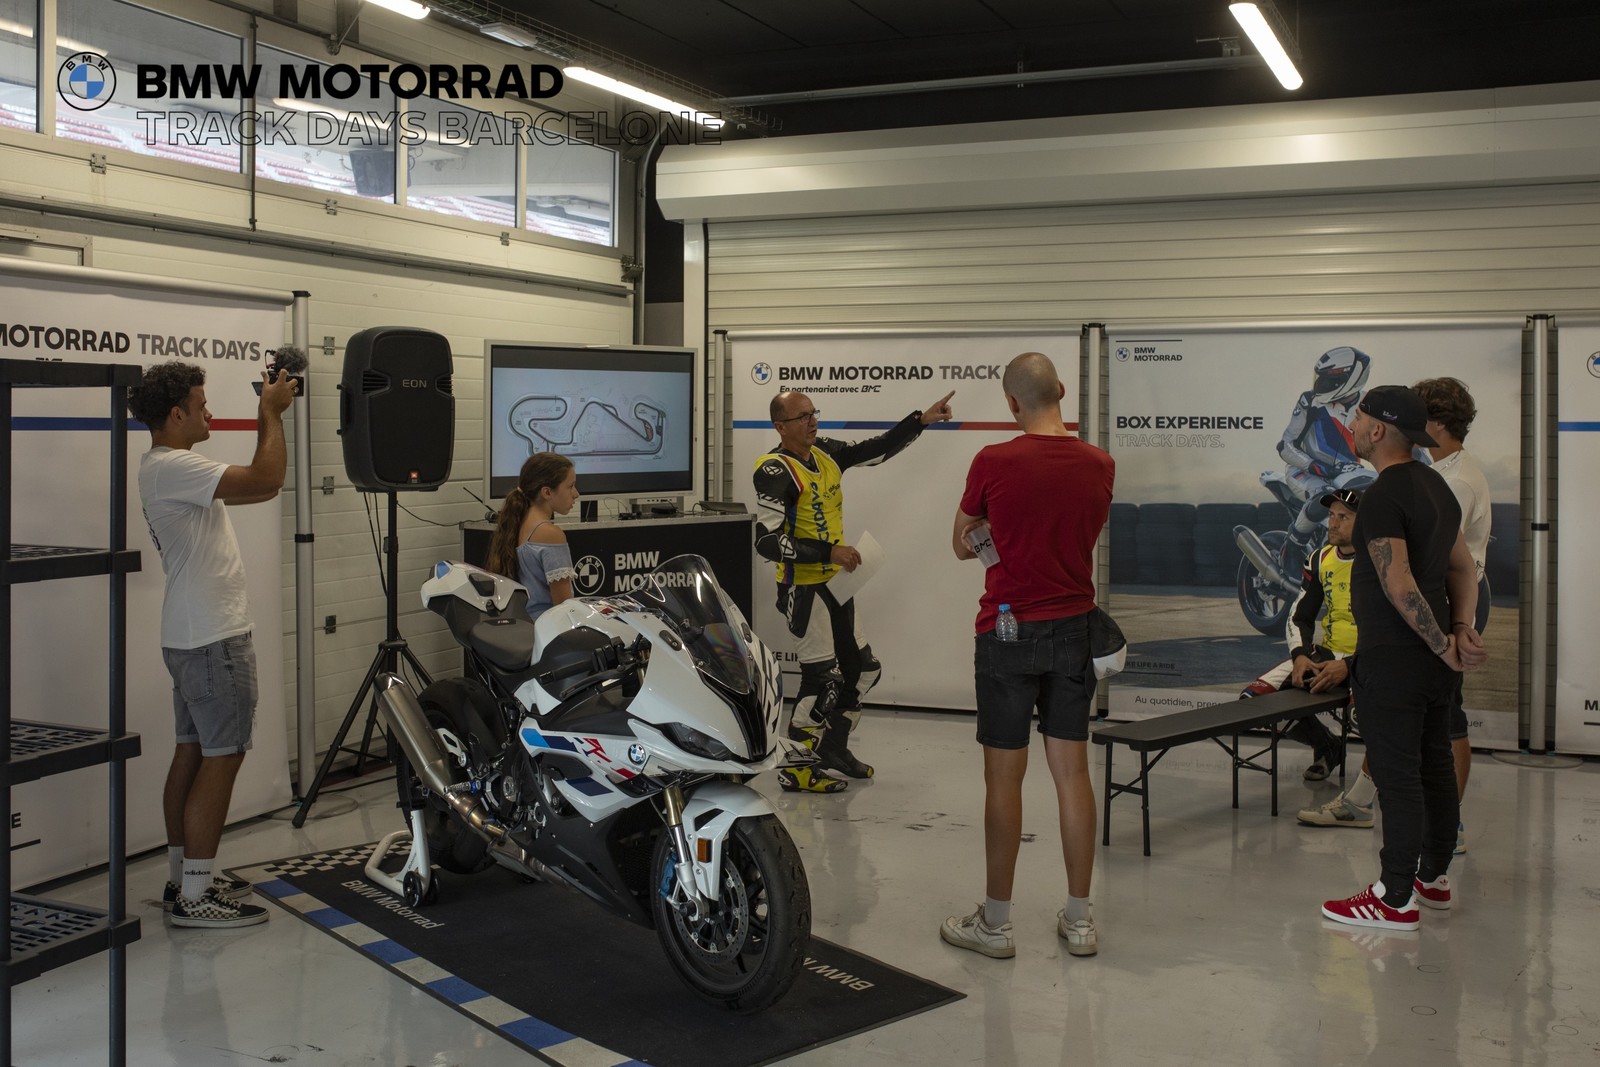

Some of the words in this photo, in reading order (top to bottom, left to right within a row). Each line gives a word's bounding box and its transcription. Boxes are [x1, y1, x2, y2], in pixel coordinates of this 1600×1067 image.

[137, 333, 208, 358] TRACK
[212, 339, 261, 361] DAYS
[1134, 354, 1183, 362] MOTORRAD
[779, 366, 824, 381] BMW
[829, 366, 934, 381] MOTORRAD
[939, 365, 1001, 380] TRACK
[402, 379, 427, 388] EON
[861, 385, 881, 393] BMC
[1116, 416, 1151, 429] BOX
[1155, 416, 1264, 430] EXPERIENCE
[1116, 433, 1173, 447] TRACK
[1176, 433, 1226, 448] DAYS.
[974, 538, 992, 553] BMC
[614, 551, 660, 571] BMW
[614, 571, 705, 593] MOTORRA
[1135, 695, 1147, 704] Au
[1150, 697, 1194, 708] quotidien,
[341, 880, 384, 899] BMW
[373, 893, 445, 930] Motorrad
[808, 965, 875, 991] BMW
